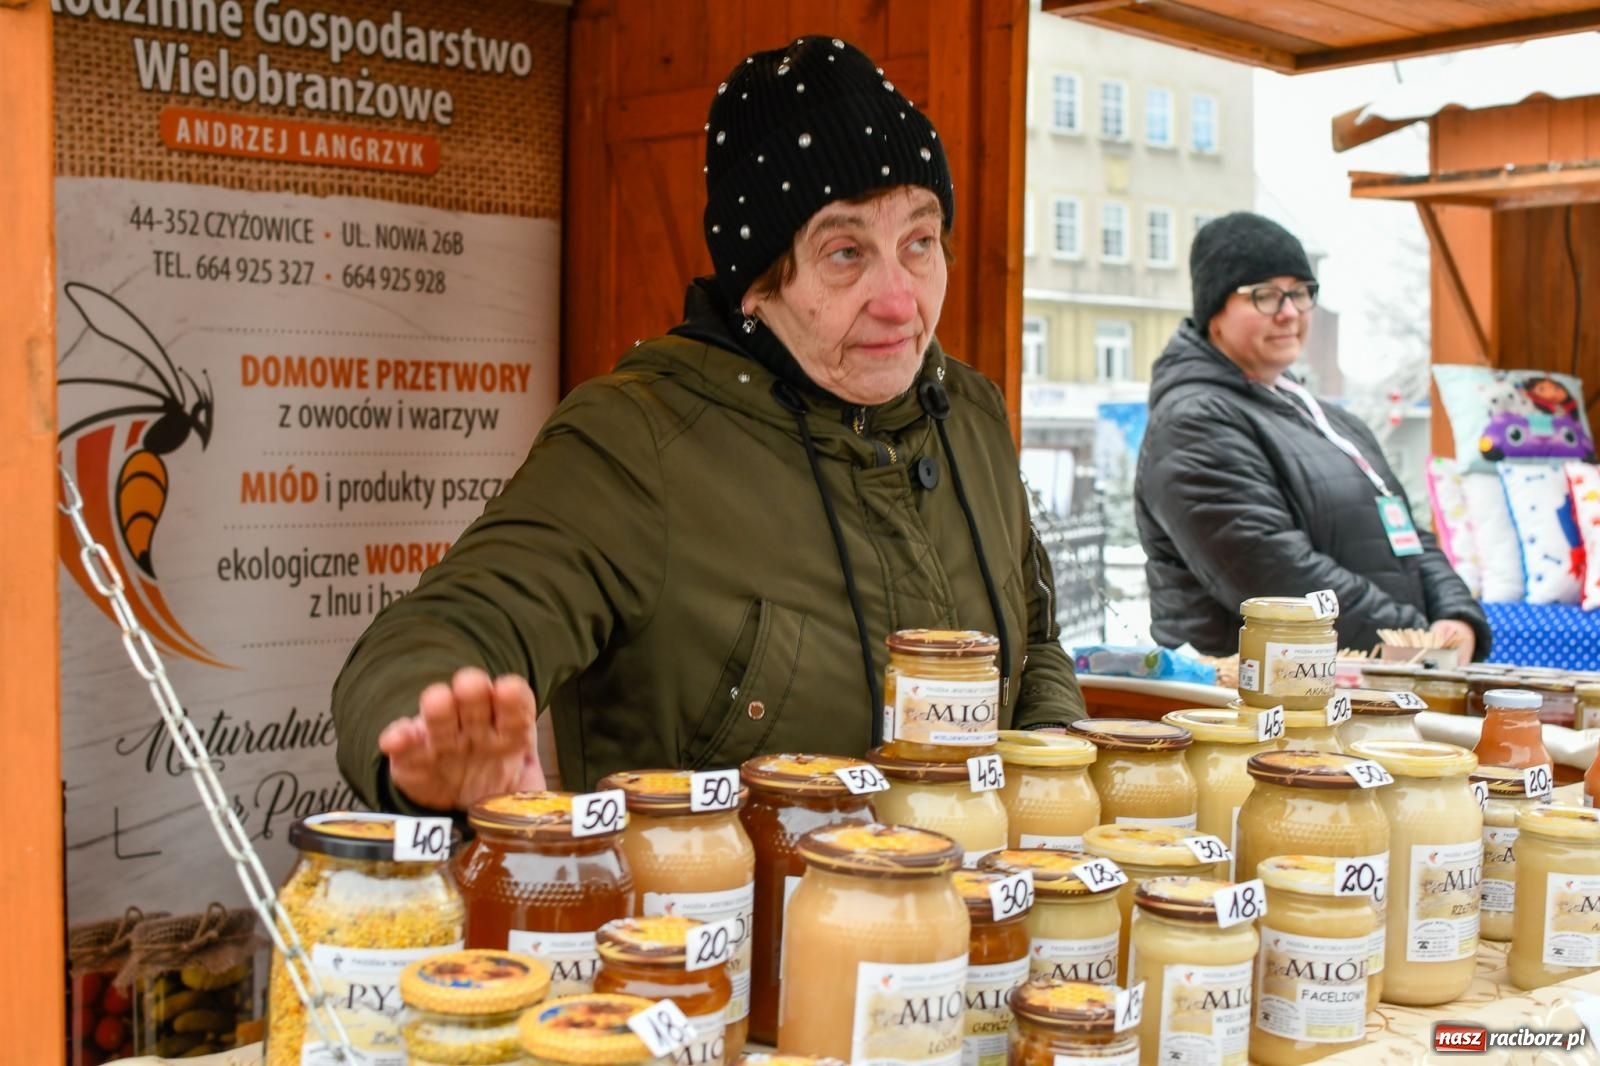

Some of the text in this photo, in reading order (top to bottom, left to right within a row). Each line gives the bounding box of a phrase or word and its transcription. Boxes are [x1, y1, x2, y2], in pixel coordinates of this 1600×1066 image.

[254, 0, 532, 76] Gospodarstwo
[133, 37, 454, 125] Wielobranżowe
[176, 117, 426, 168] ANDRZEJ LANGRZYK
[129, 206, 464, 256] 44-352 CZYŻOWICE UL. NOWA 26B
[153, 250, 447, 294] TEL. 664 925 327 664 925 928
[241, 355, 532, 393] DOMOWE PRZETWORY
[279, 397, 500, 438] z owoców i warzyw
[240, 464, 319, 504] MIÓD
[325, 473, 331, 503] i
[338, 471, 436, 511] produkty
[217, 542, 452, 587] ekologiczne WORK
[310, 595, 321, 618] z
[327, 585, 361, 617] lnu
[368, 585, 374, 614] i
